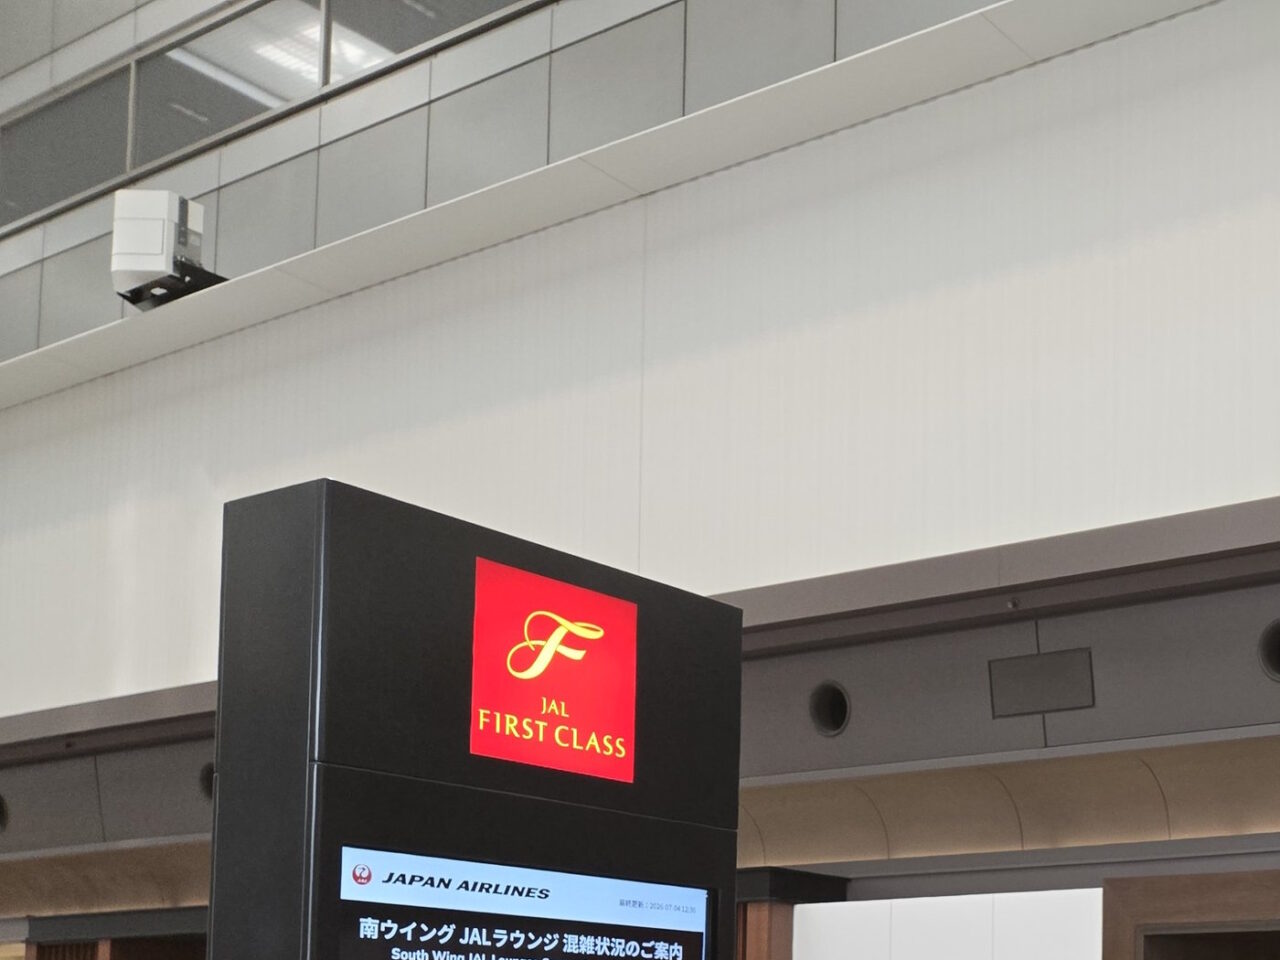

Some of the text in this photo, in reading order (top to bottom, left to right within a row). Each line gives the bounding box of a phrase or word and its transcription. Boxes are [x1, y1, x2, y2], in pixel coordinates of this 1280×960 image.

[507, 610, 605, 680] F
[541, 697, 570, 718] JAL
[479, 709, 627, 758] FIRST CLASS
[382, 873, 551, 899] JAPAN AIRLINES
[359, 917, 456, 945] 南ウイング
[459, 927, 560, 952] JALラウンジ
